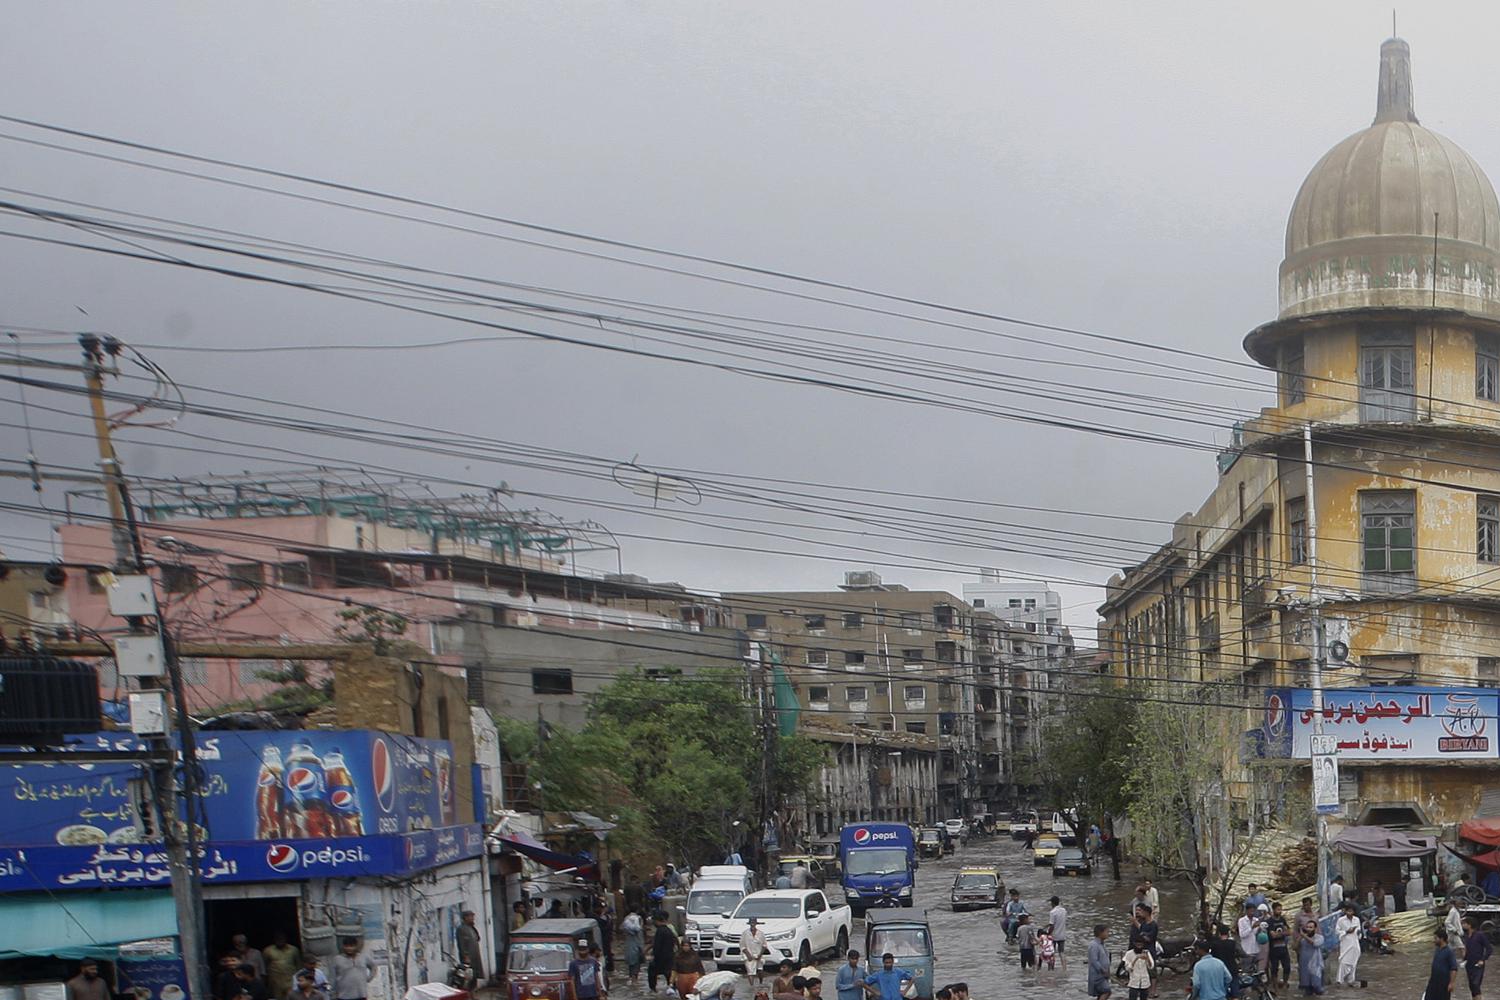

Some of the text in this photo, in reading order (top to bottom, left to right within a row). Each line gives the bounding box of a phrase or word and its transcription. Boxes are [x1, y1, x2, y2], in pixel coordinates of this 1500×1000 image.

[1439, 737, 1489, 752] BIRYANI
[872, 831, 899, 842] pepsi
[302, 845, 364, 867] pepsi
